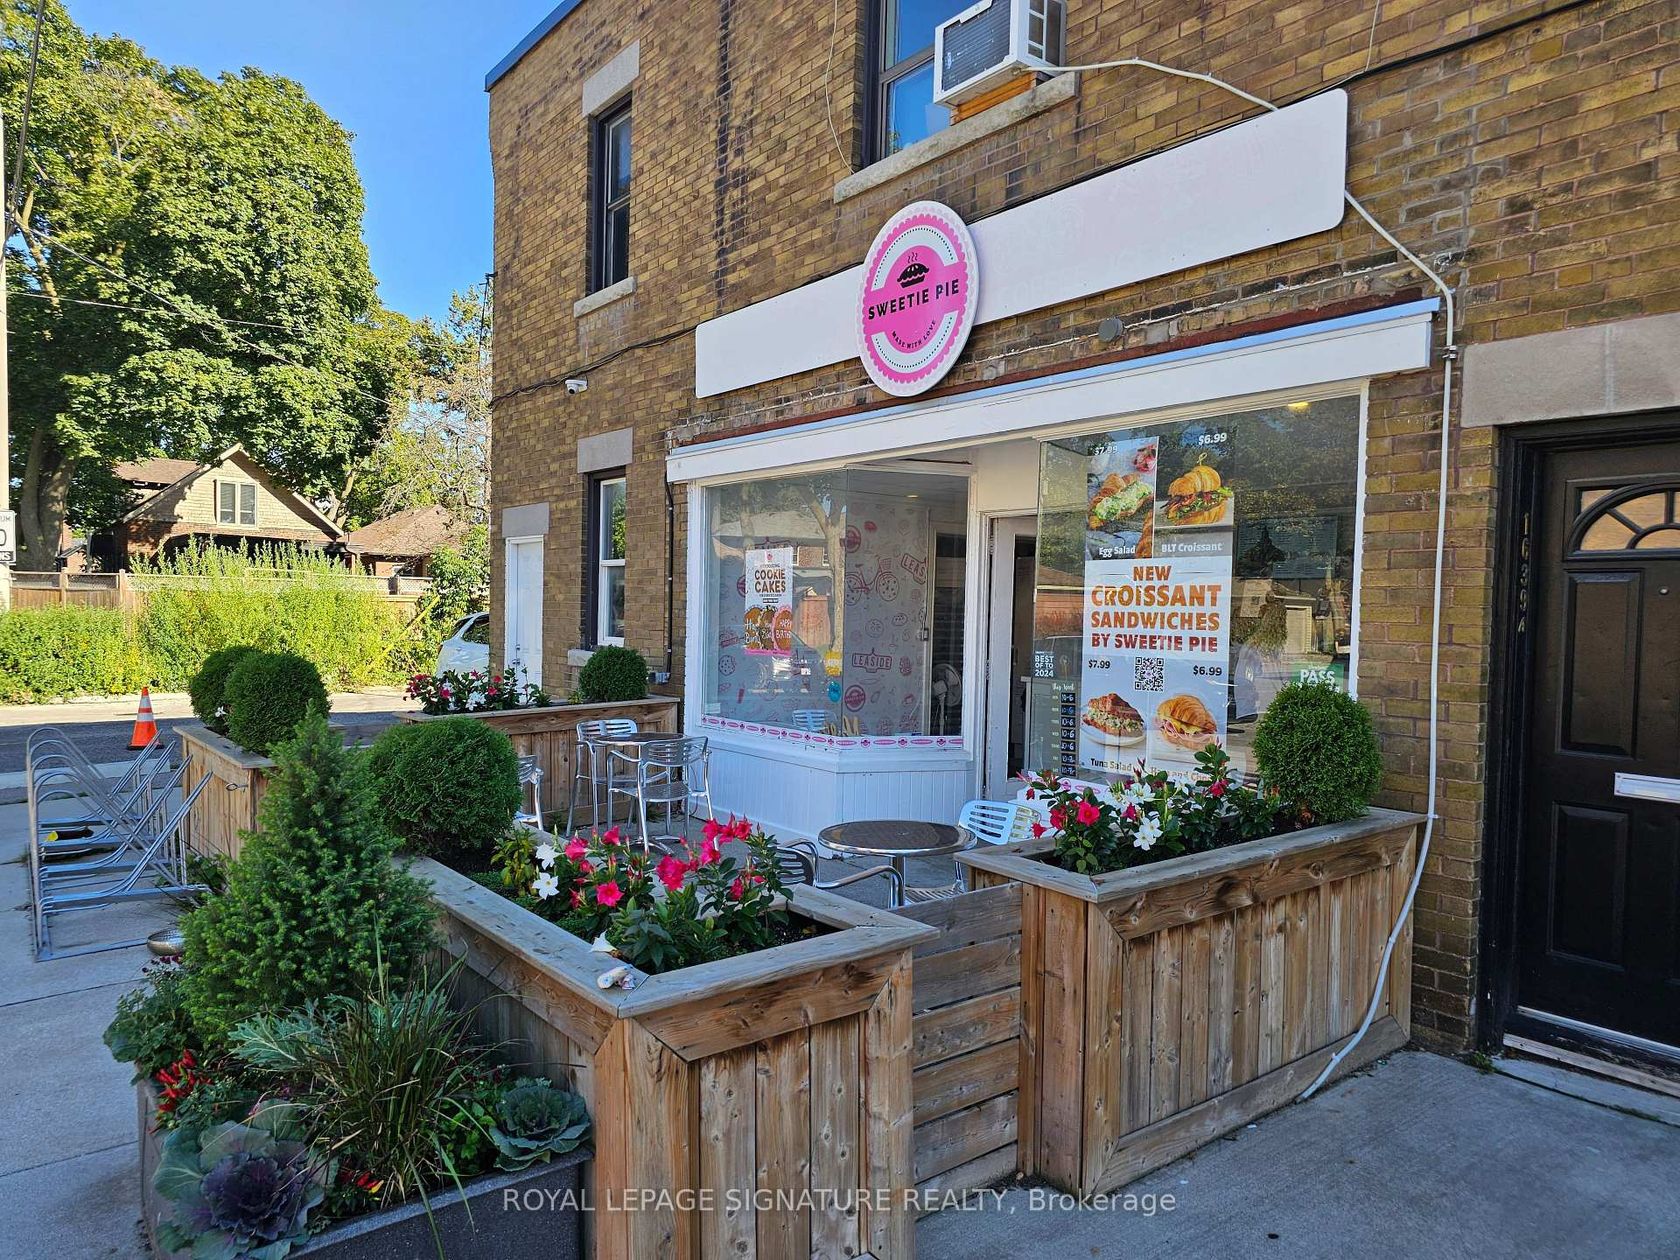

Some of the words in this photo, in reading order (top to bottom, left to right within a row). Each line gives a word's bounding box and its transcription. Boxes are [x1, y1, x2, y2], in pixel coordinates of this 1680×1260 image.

[868, 289, 929, 320] SWEETIE
[935, 278, 960, 301] PIE
[923, 320, 936, 341] LOVE
[1198, 432, 1228, 446] $6.99
[1099, 546, 1112, 558] Egg
[1114, 544, 1136, 555] Salad
[1161, 543, 1177, 553] BLT
[1178, 541, 1223, 552] Croissant
[754, 569, 786, 580] COOKIE
[1133, 565, 1172, 582] NEW
[754, 580, 786, 593] CAKES
[1091, 584, 1222, 607] CROISSANT
[1091, 611, 1220, 631] SANDWICHES
[1091, 633, 1111, 648] BY
[1114, 633, 1183, 651] SWEETIE
[1189, 636, 1218, 653] PIE
[853, 655, 891, 668] LEASIDE
[1035, 655, 1055, 663] BEST
[1088, 660, 1111, 669] $7.99
[1034, 669, 1054, 677] 2024
[1193, 665, 1222, 676] $6.99
[1300, 669, 1336, 686] PASS
[1090, 758, 1108, 768] Tuna
[1110, 760, 1132, 771] Salad
